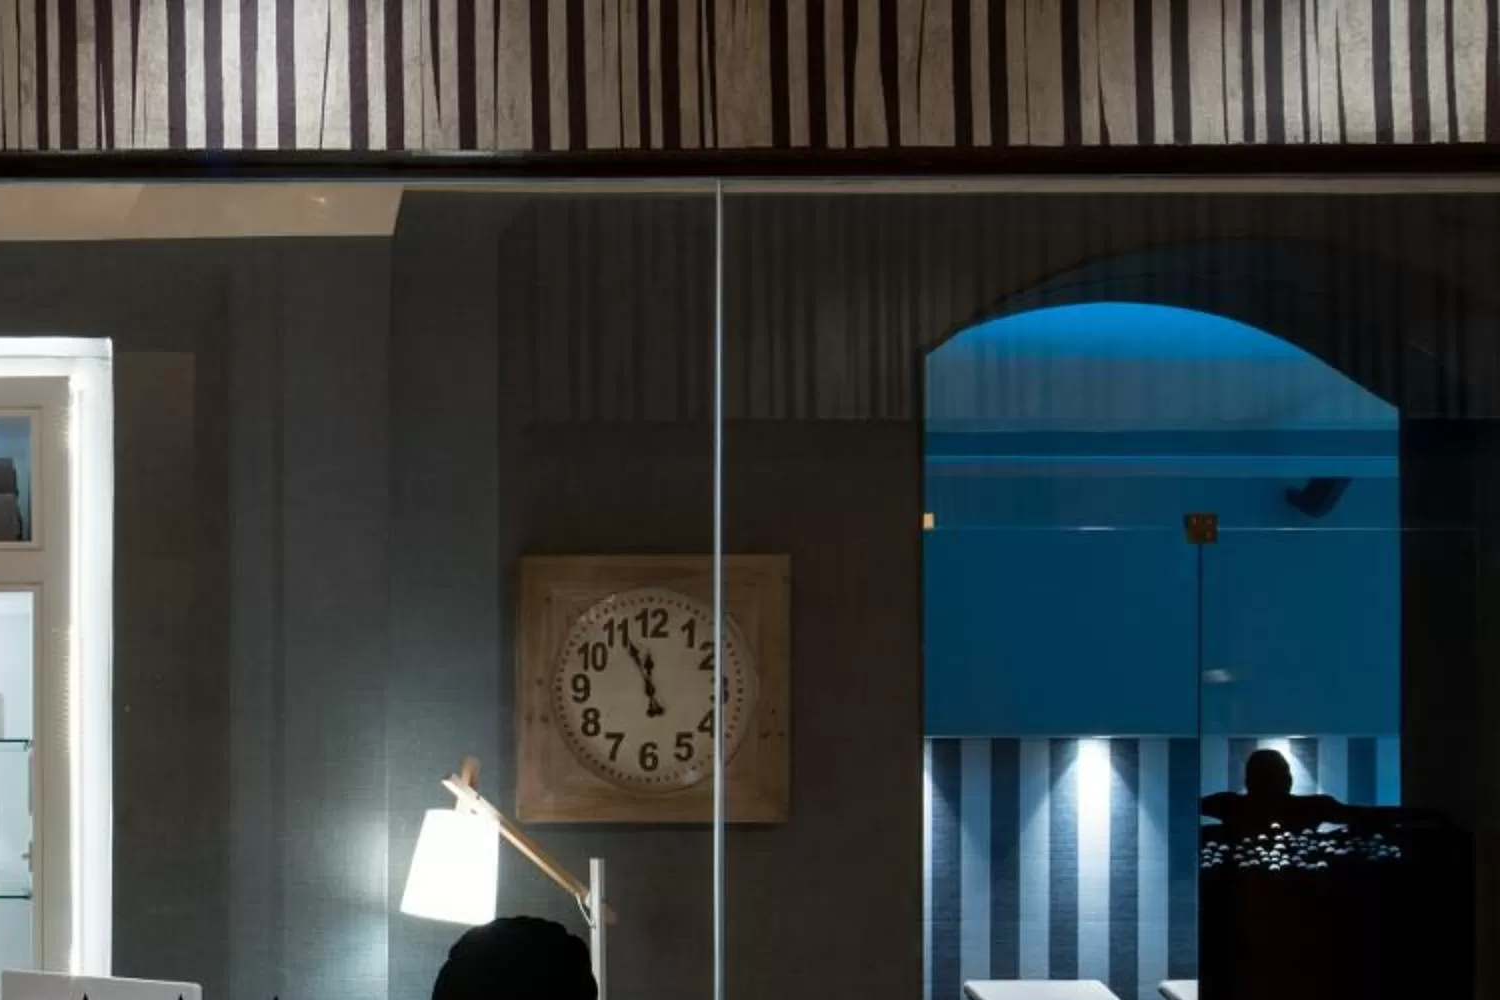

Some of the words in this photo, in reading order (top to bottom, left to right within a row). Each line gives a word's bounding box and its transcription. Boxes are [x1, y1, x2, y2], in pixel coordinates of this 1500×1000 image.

[602, 617, 629, 648] 11
[634, 608, 669, 638] 12
[680, 617, 696, 648] 1
[577, 641, 608, 672] 10
[697, 641, 715, 671] 2
[571, 673, 591, 703] 9
[581, 707, 601, 737] 8
[697, 708, 716, 738] 4
[605, 732, 625, 762] 7
[639, 742, 659, 772] 6
[674, 732, 695, 762] 5
